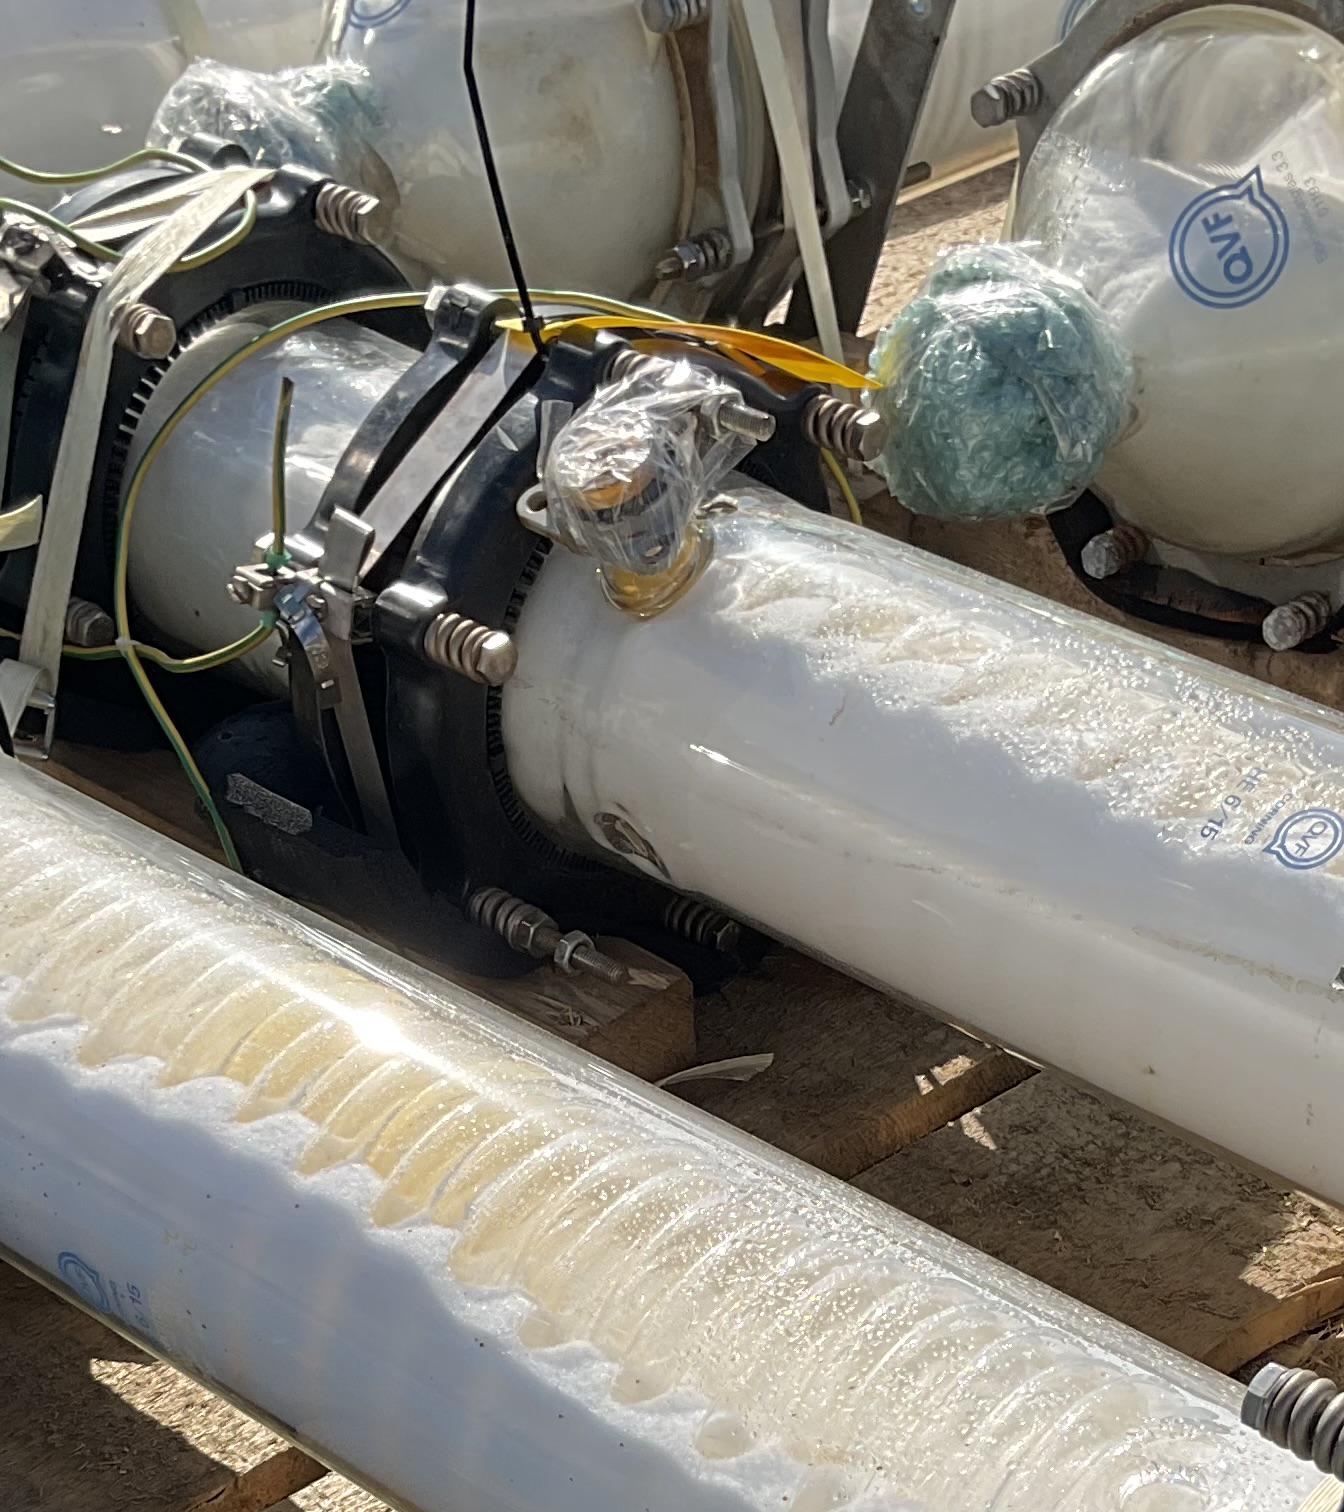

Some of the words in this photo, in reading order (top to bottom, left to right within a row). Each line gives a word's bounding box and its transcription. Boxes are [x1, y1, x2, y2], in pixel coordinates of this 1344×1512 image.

[1201, 212, 1253, 284] QVF
[1200, 794, 1242, 841] 6/15
[1244, 793, 1293, 845] CORNING
[1294, 821, 1328, 857] QVF
